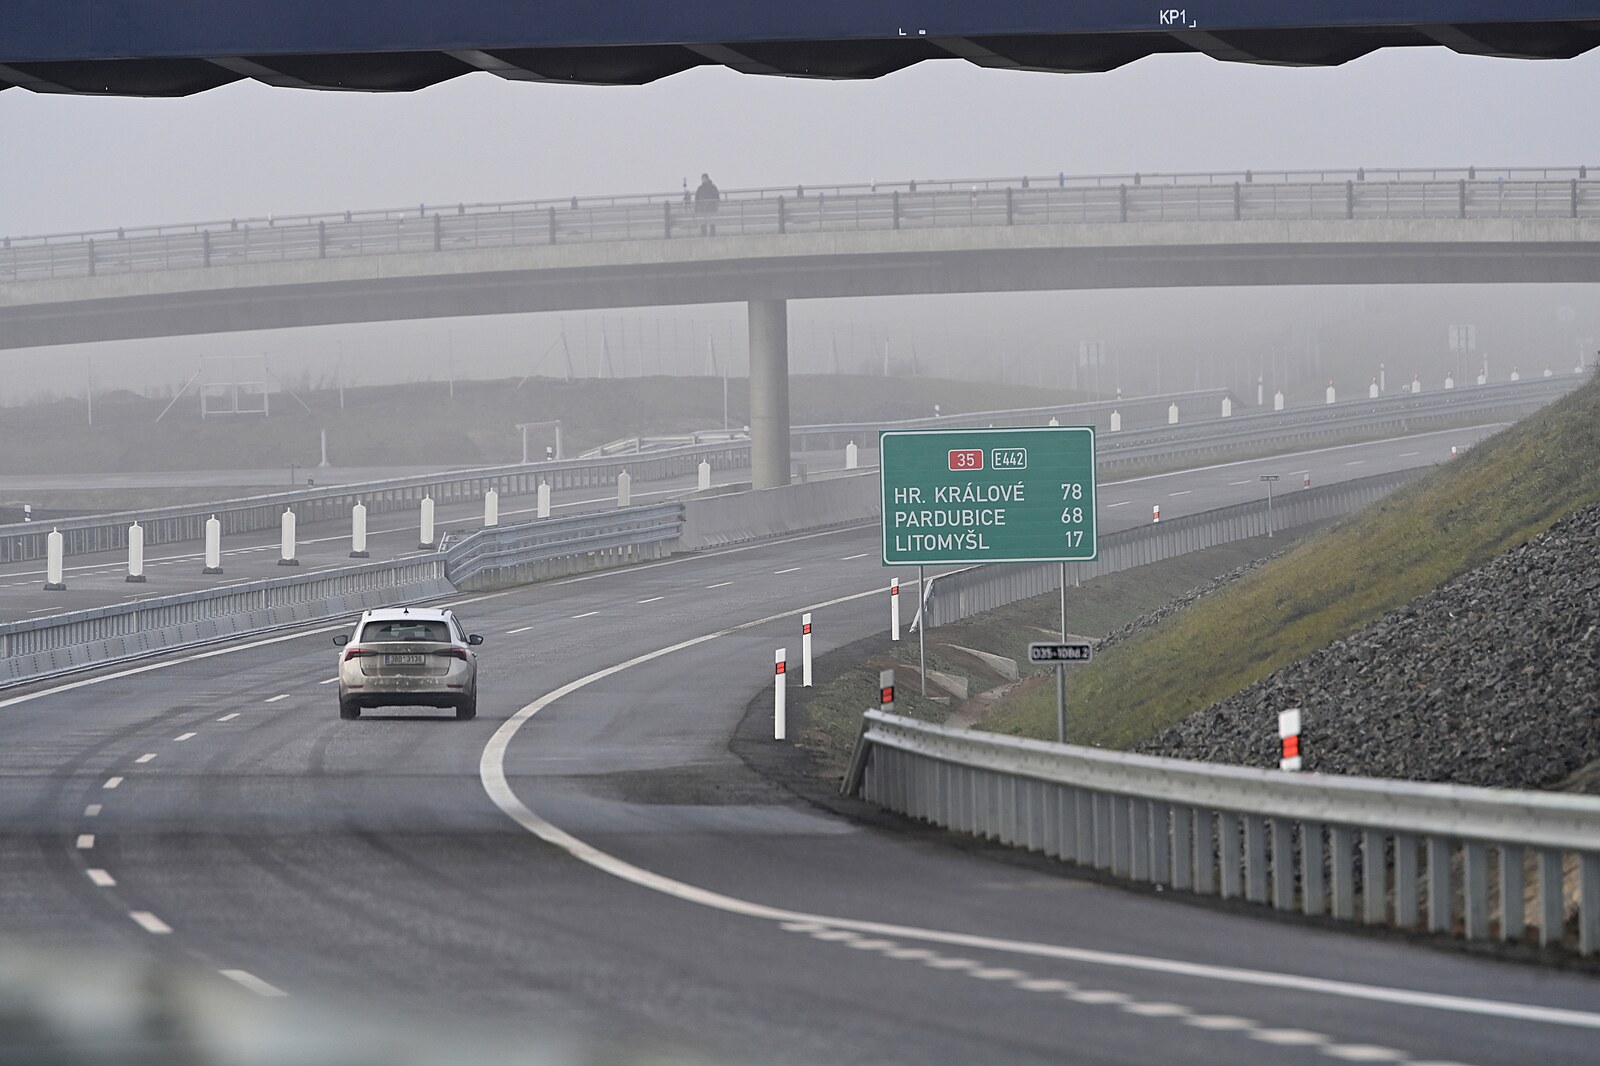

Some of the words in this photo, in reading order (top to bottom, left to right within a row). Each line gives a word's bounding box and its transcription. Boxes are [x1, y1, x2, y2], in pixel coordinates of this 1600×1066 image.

[1159, 9, 1187, 25] KP1
[957, 453, 975, 467] 35
[995, 452, 1024, 466] E442
[894, 487, 926, 504] HR.
[934, 480, 1025, 503] KRÁLOVÉ
[1060, 483, 1083, 500] 78
[895, 508, 1006, 528] PARDUBICE
[1061, 507, 1083, 524] 68
[895, 529, 990, 551] LITOMYŠL
[1065, 530, 1084, 548] 17
